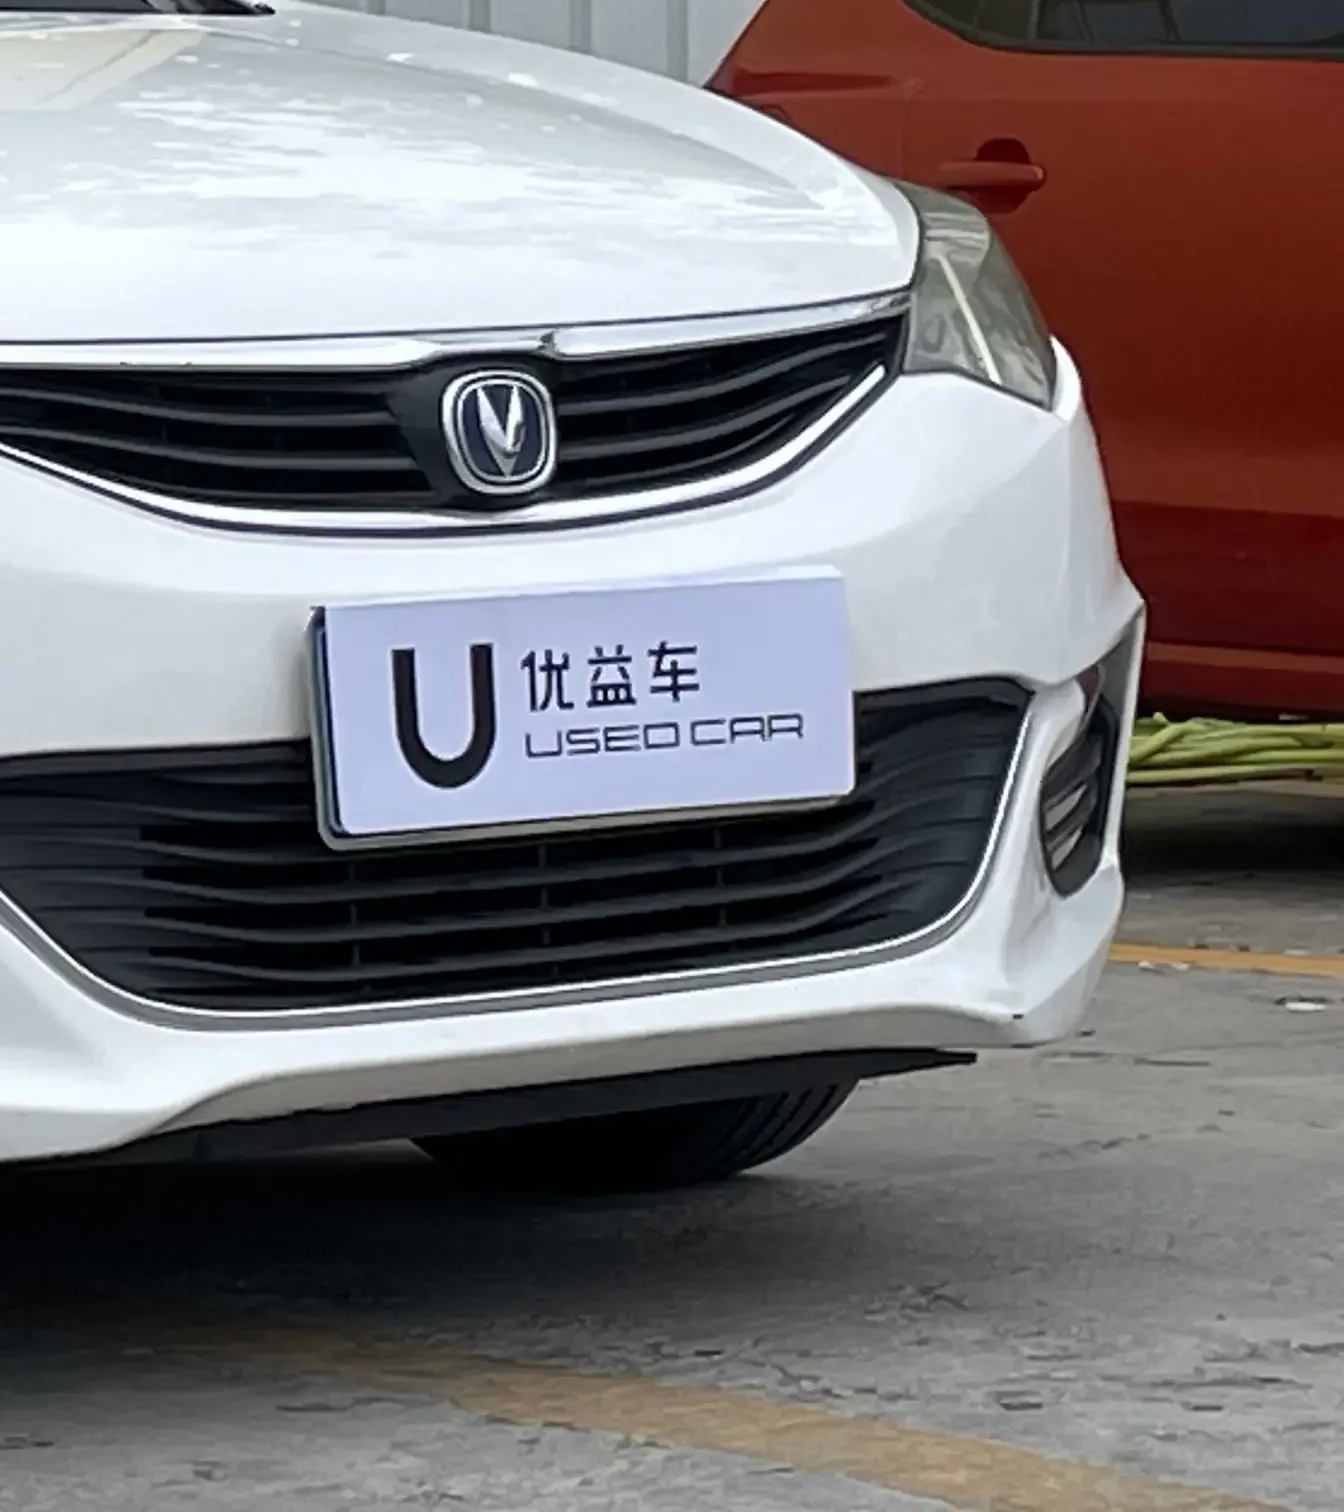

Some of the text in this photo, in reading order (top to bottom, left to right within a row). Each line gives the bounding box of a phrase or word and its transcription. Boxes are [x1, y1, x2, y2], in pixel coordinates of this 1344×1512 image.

[520, 640, 700, 712] 优益车
[391, 642, 497, 789] U
[525, 713, 804, 758] USED CAR
